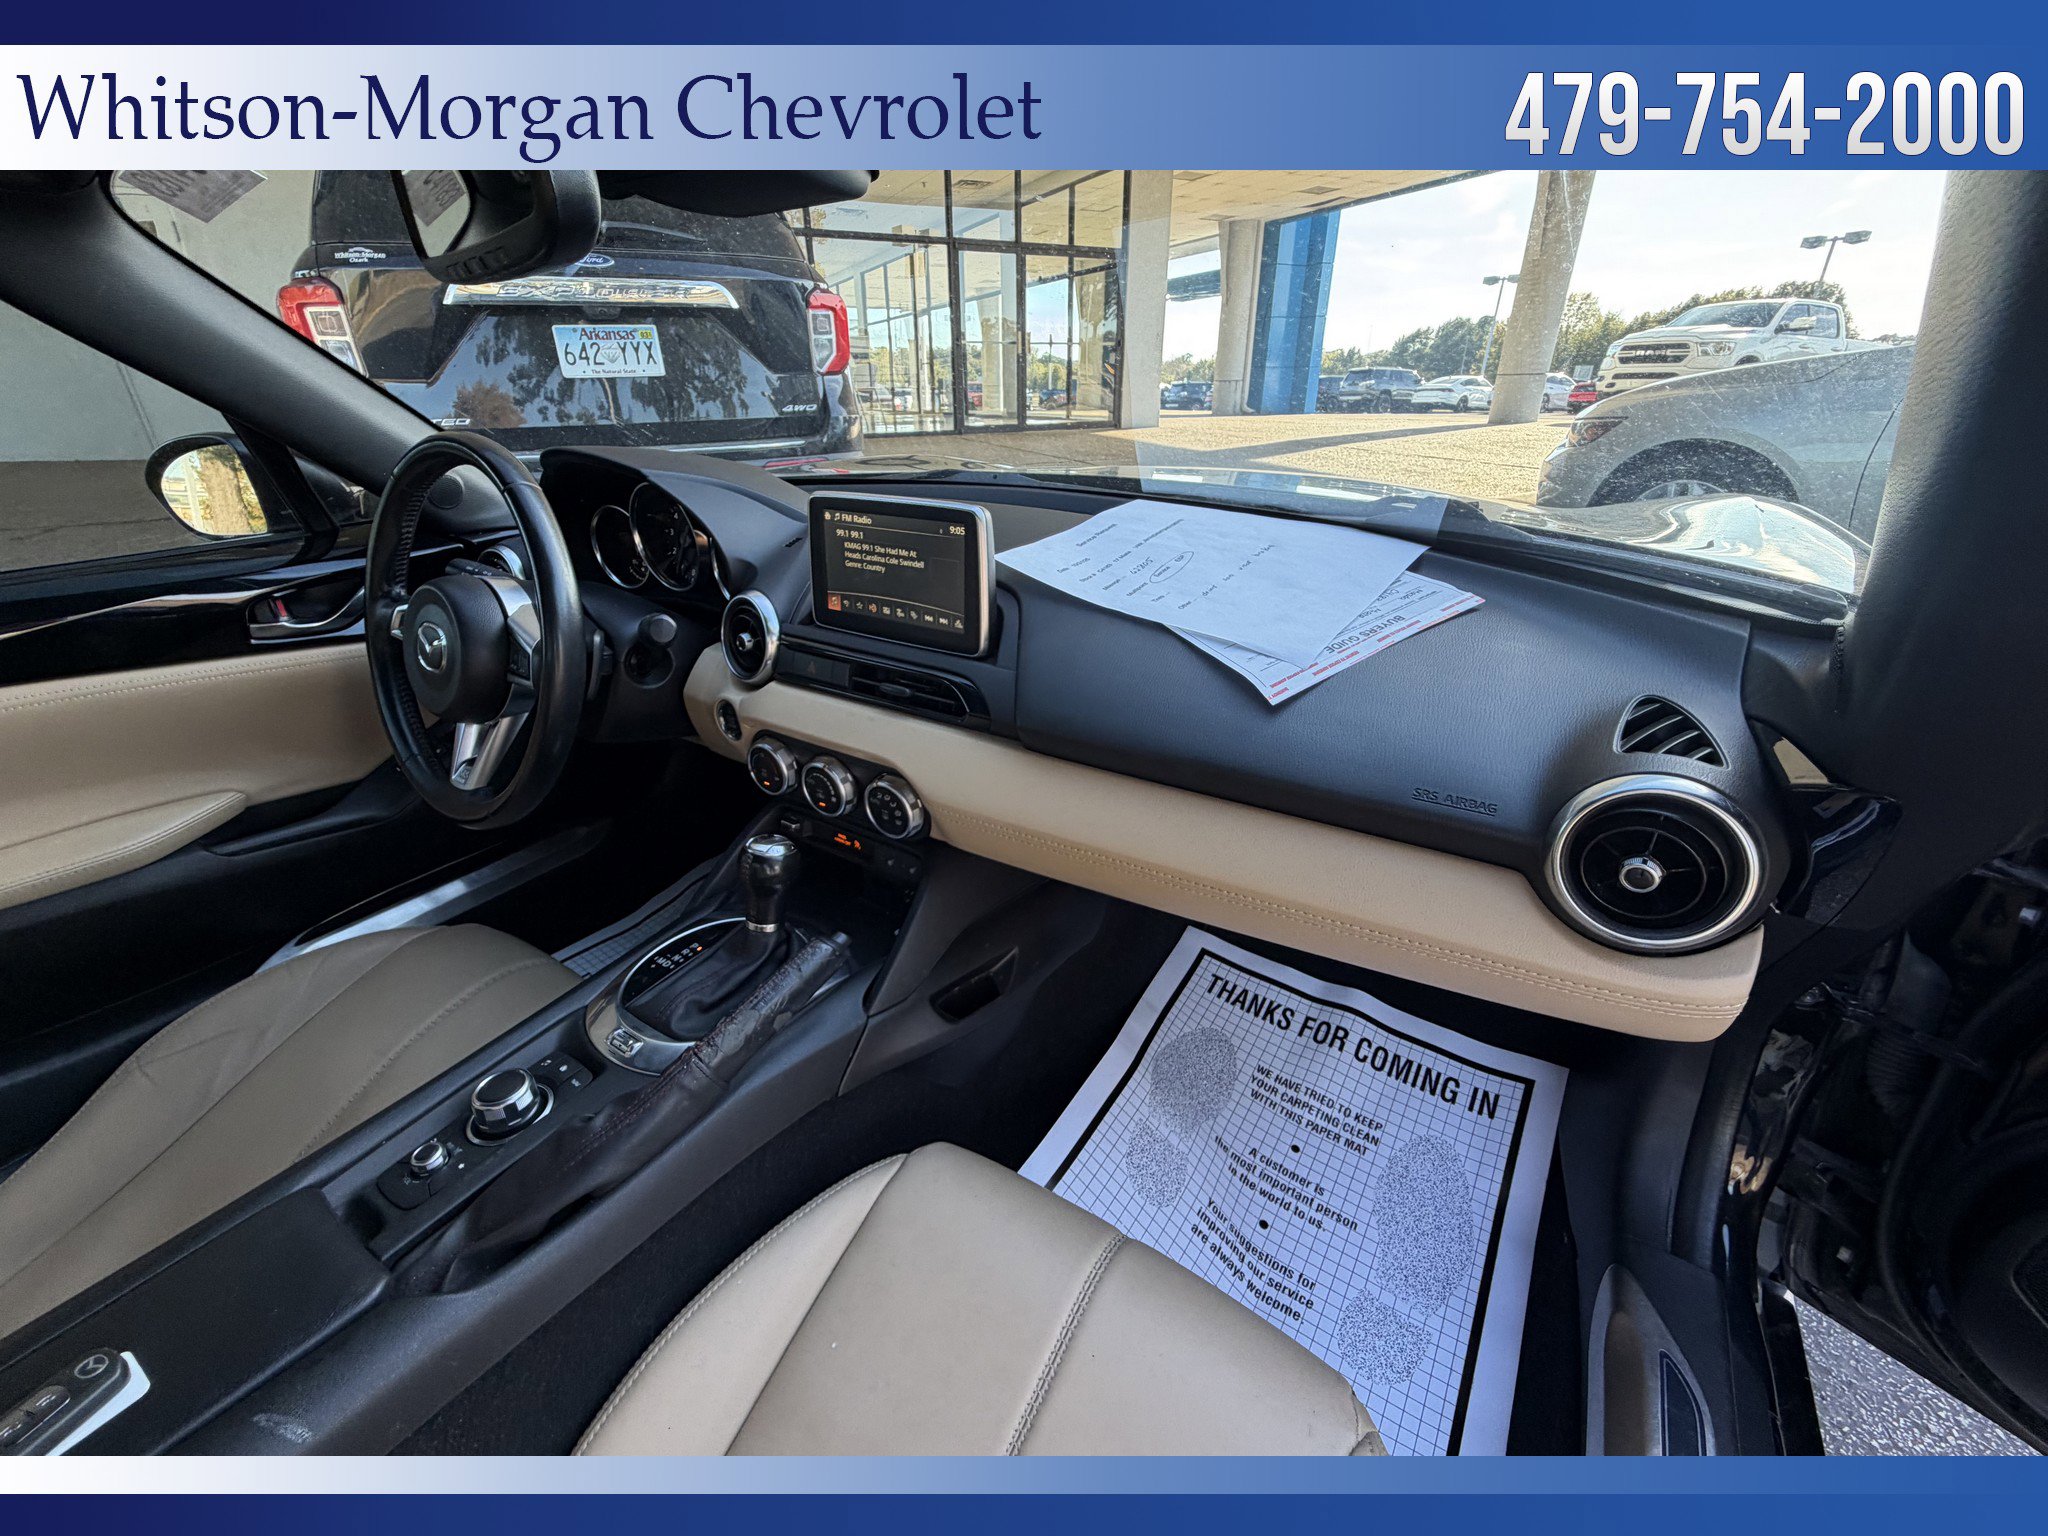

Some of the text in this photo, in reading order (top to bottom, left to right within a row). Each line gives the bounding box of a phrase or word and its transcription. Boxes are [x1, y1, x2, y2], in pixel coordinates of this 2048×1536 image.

[579, 327, 636, 341] Arkansas
[564, 341, 658, 367] 642 YYX
[841, 513, 872, 525] FM Radio
[949, 526, 966, 536] 9:05
[836, 529, 864, 539] 99.1 99.1
[844, 550, 925, 569] Heads Carolina Cole Swindell
[886, 547, 898, 556] Had
[862, 562, 886, 574] Country
[1358, 614, 1406, 638] BUYERS
[1325, 634, 1360, 654] GUIDE
[1412, 787, 1498, 814] SRS AIRBAG
[1206, 973, 1501, 1121] THANKS FOR COMING IN
[1250, 1074, 1381, 1147] YOUR CARPETING CLEAN
[1256, 1063, 1384, 1132] WE HAVE TRIED TO KEEP
[1249, 1087, 1371, 1157] WITH THIS PAPER MAT
[1214, 1135, 1358, 1232] the most important person
[1249, 1147, 1325, 1197] A customer is
[1227, 1162, 1238, 1178] in
[1238, 1171, 1258, 1192] the
[1258, 1186, 1292, 1213] world
[1292, 1205, 1306, 1222] to
[1190, 1223, 1209, 1245] are
[1209, 1241, 1246, 1283] always
[1205, 1196, 1317, 1292] Your suggestions for
[1196, 1206, 1315, 1310] improving our service
